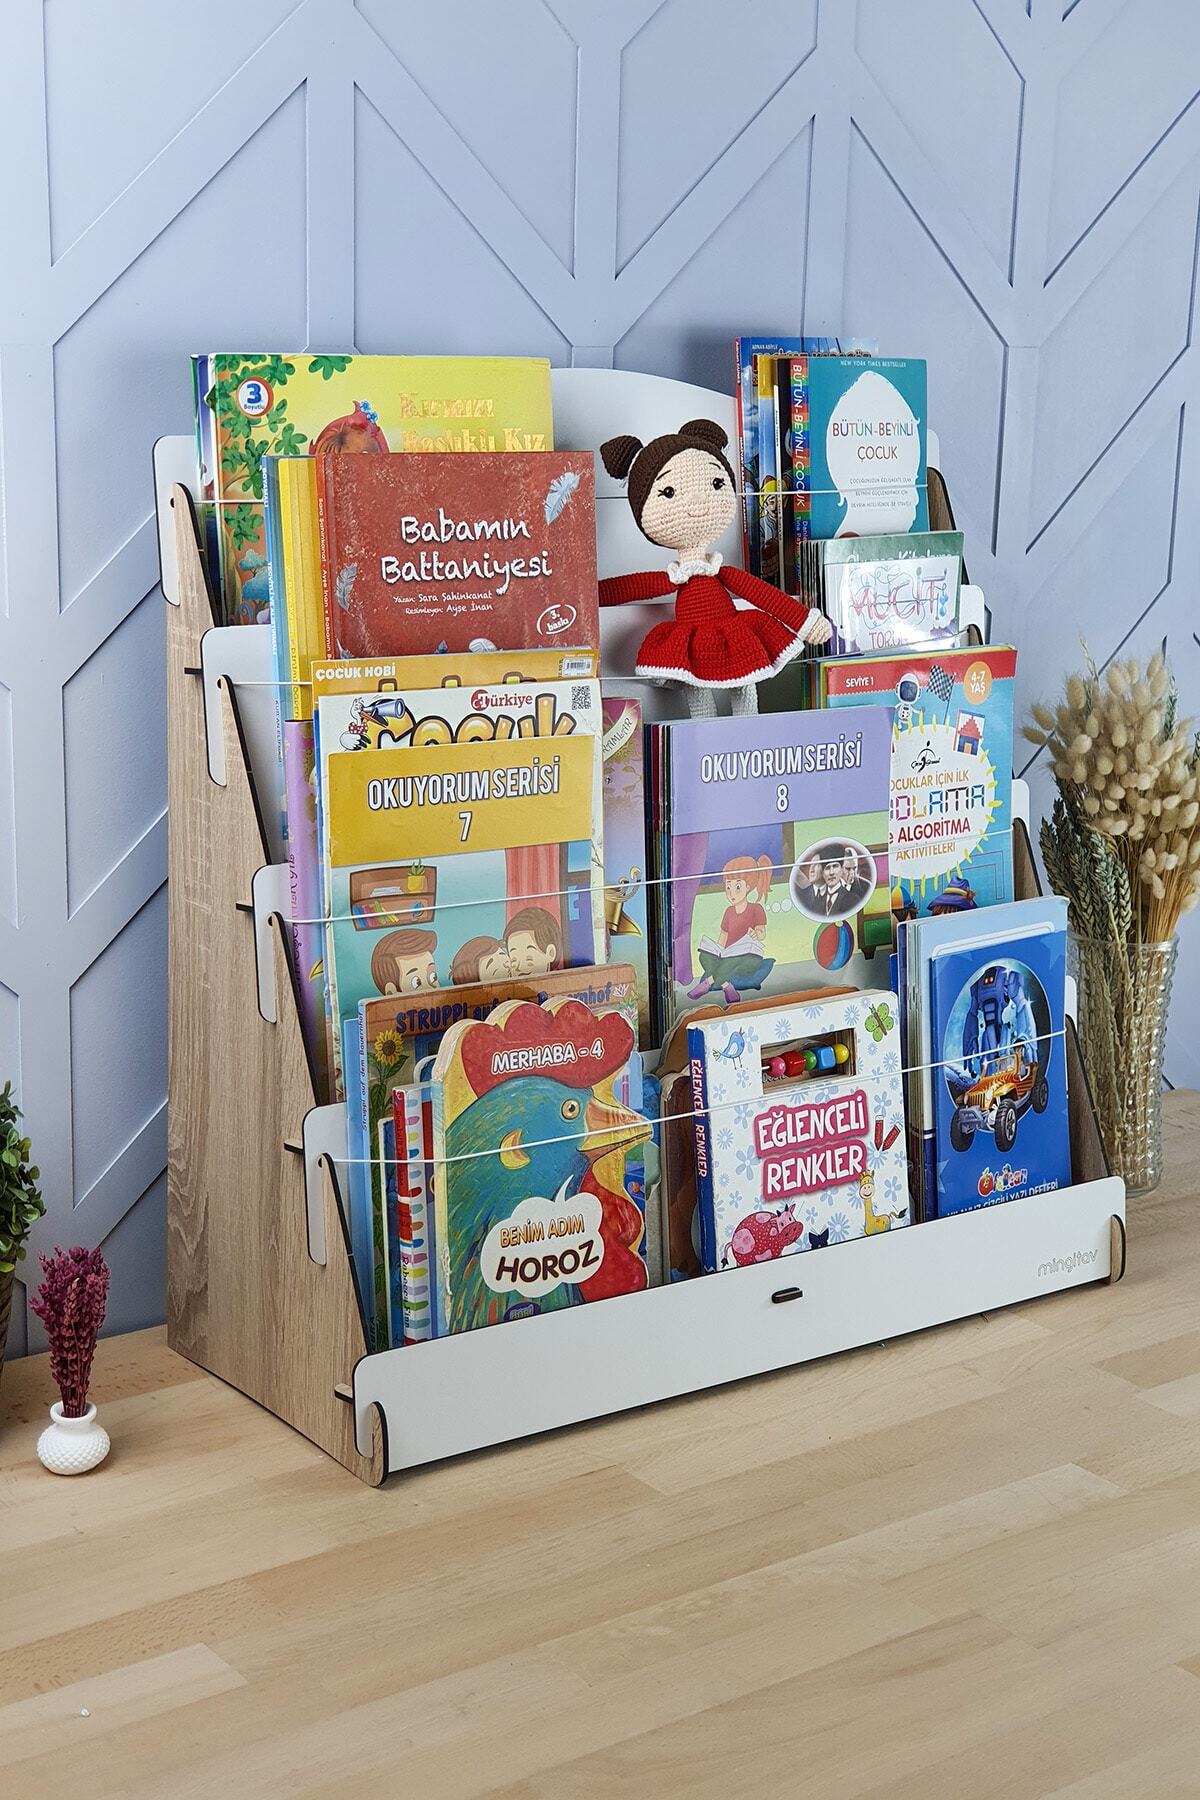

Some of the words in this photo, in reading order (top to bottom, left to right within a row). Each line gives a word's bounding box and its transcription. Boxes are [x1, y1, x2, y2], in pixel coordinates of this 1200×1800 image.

[246, 383, 262, 404] 3
[504, 427, 546, 452] Kız
[857, 446, 898, 463] ÇOCUK
[401, 508, 531, 544] Babamın
[381, 550, 553, 595] Battaniyesi
[418, 592, 439, 603] Sara
[442, 590, 493, 602] Şahinkanat
[446, 604, 468, 616] Ayşe
[471, 601, 494, 611] İnan
[547, 617, 569, 631] baskı
[550, 610, 560, 620] 3.
[316, 667, 361, 682] ÇOCUK
[364, 662, 396, 677] HOBİ
[846, 675, 870, 688] SEVİYE
[871, 676, 874, 686] 1
[971, 671, 986, 682] 4-7
[970, 681, 986, 696] YAŞ
[701, 745, 803, 783] OKUYORUM
[803, 732, 863, 771] SERİSİ
[367, 769, 490, 810] OKUYORUM
[491, 755, 561, 799] SERİSİ
[891, 774, 933, 791] OCUKLAR
[935, 770, 954, 787] İÇİN
[956, 768, 969, 782] İLK
[775, 784, 789, 813] 8
[458, 811, 473, 842] 7
[898, 817, 971, 844] ALGORİTMA
[396, 1002, 468, 1033] STRUPPI
[492, 1042, 577, 1074] MERHABA
[590, 1037, 605, 1059] 4
[757, 1095, 866, 1151] EĞLENCELİ
[695, 1124, 708, 1178] RENKLER
[766, 1147, 864, 1196] RENKLER
[500, 1219, 545, 1248] BENİM
[547, 1213, 585, 1241] ADIM
[495, 1240, 600, 1284] HOROZ
[403, 1305, 412, 1328] Finn
